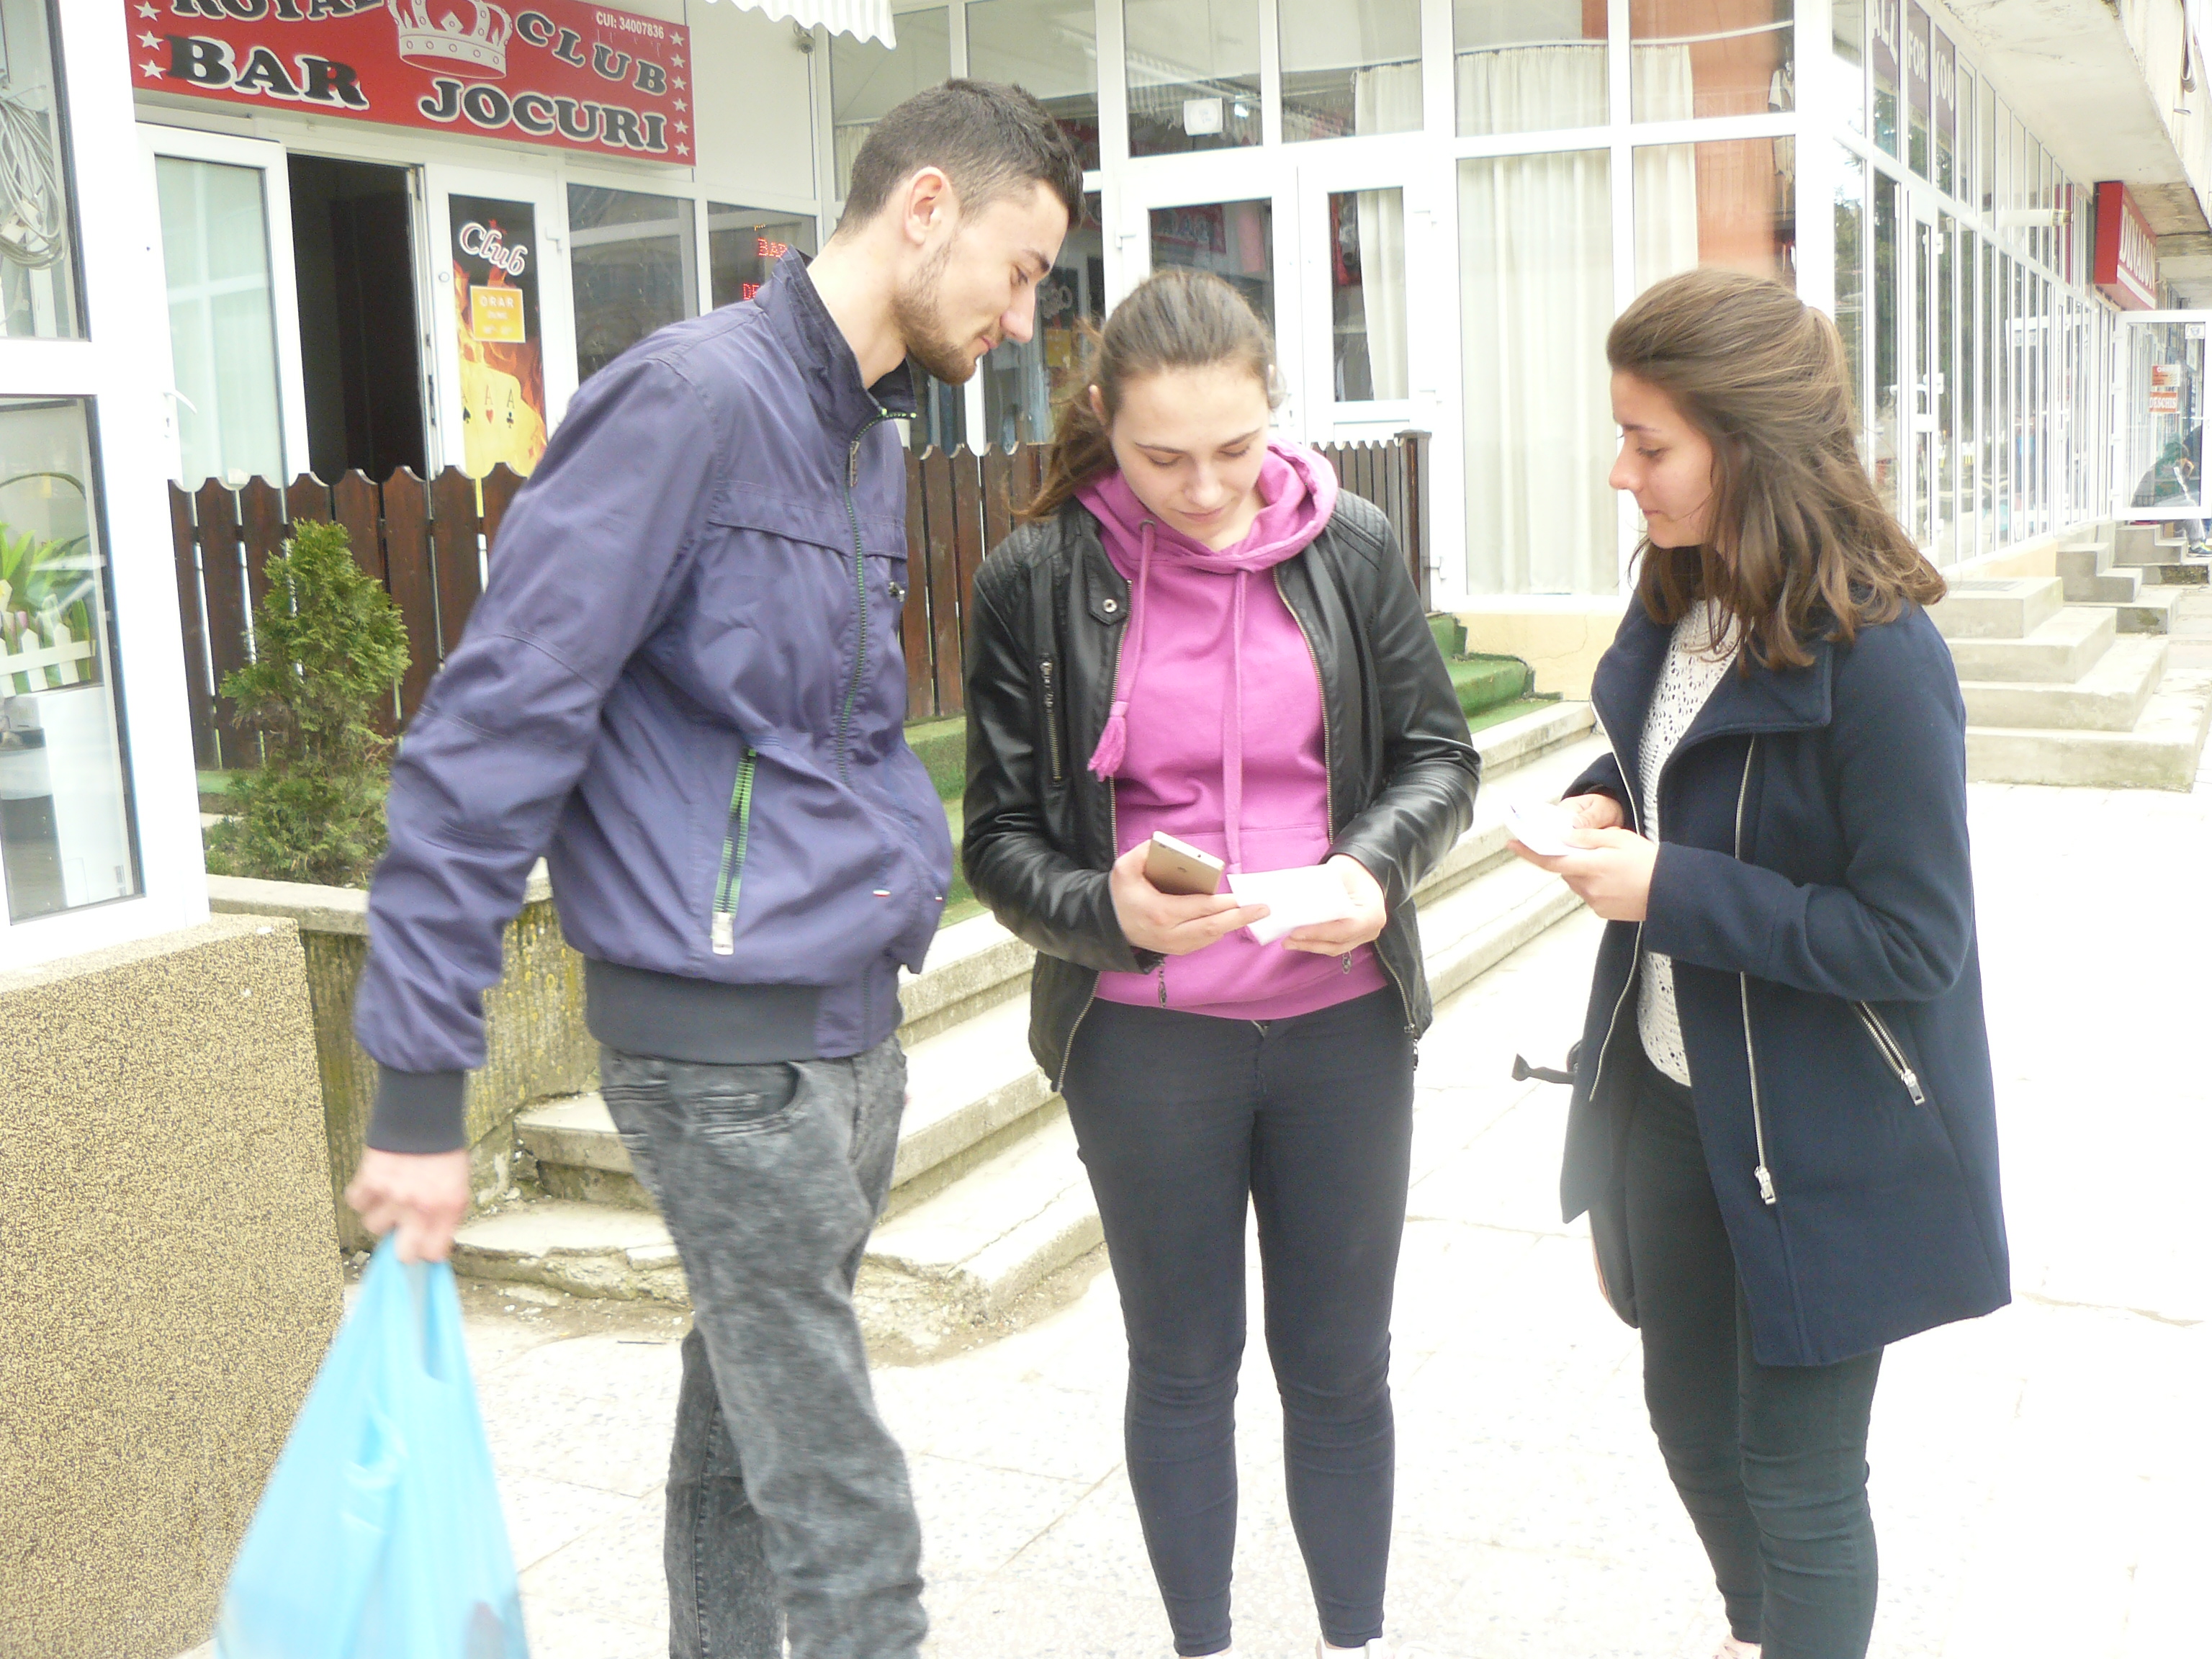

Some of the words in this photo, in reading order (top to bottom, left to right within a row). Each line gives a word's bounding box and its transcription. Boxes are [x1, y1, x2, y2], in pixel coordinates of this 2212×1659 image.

[596, 11, 617, 29] CUI:
[619, 17, 665, 40] 34007836
[517, 11, 669, 96] CLUB
[1907, 29, 1927, 83] FOR
[165, 34, 370, 111] BAR
[419, 78, 670, 153] JOCURI
[459, 222, 529, 276] Club
[480, 295, 514, 309] ORAR
